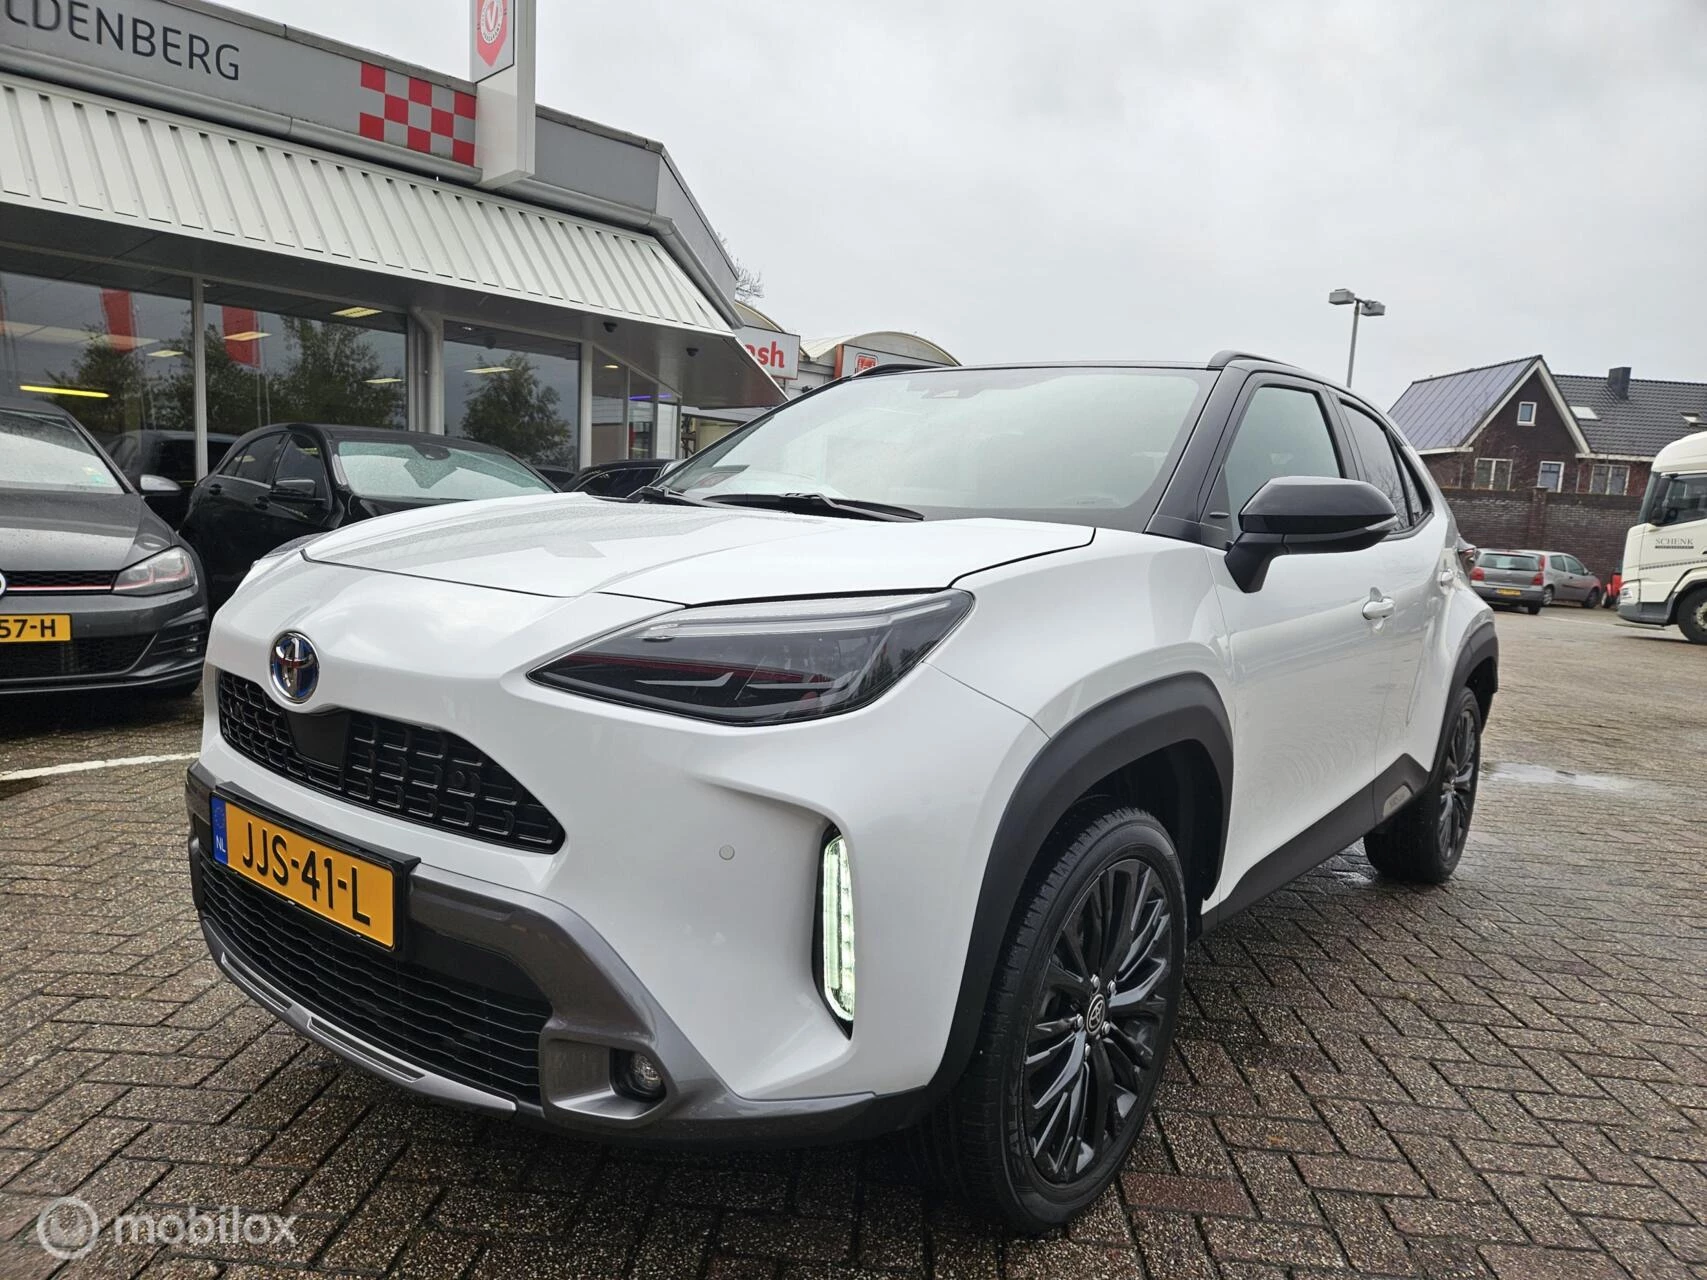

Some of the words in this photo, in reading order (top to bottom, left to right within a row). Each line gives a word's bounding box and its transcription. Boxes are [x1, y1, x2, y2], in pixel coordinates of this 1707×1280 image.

[1655, 537, 1695, 545] SCHENK
[215, 835, 227, 853] NL
[242, 821, 371, 926] JJS-41-L
